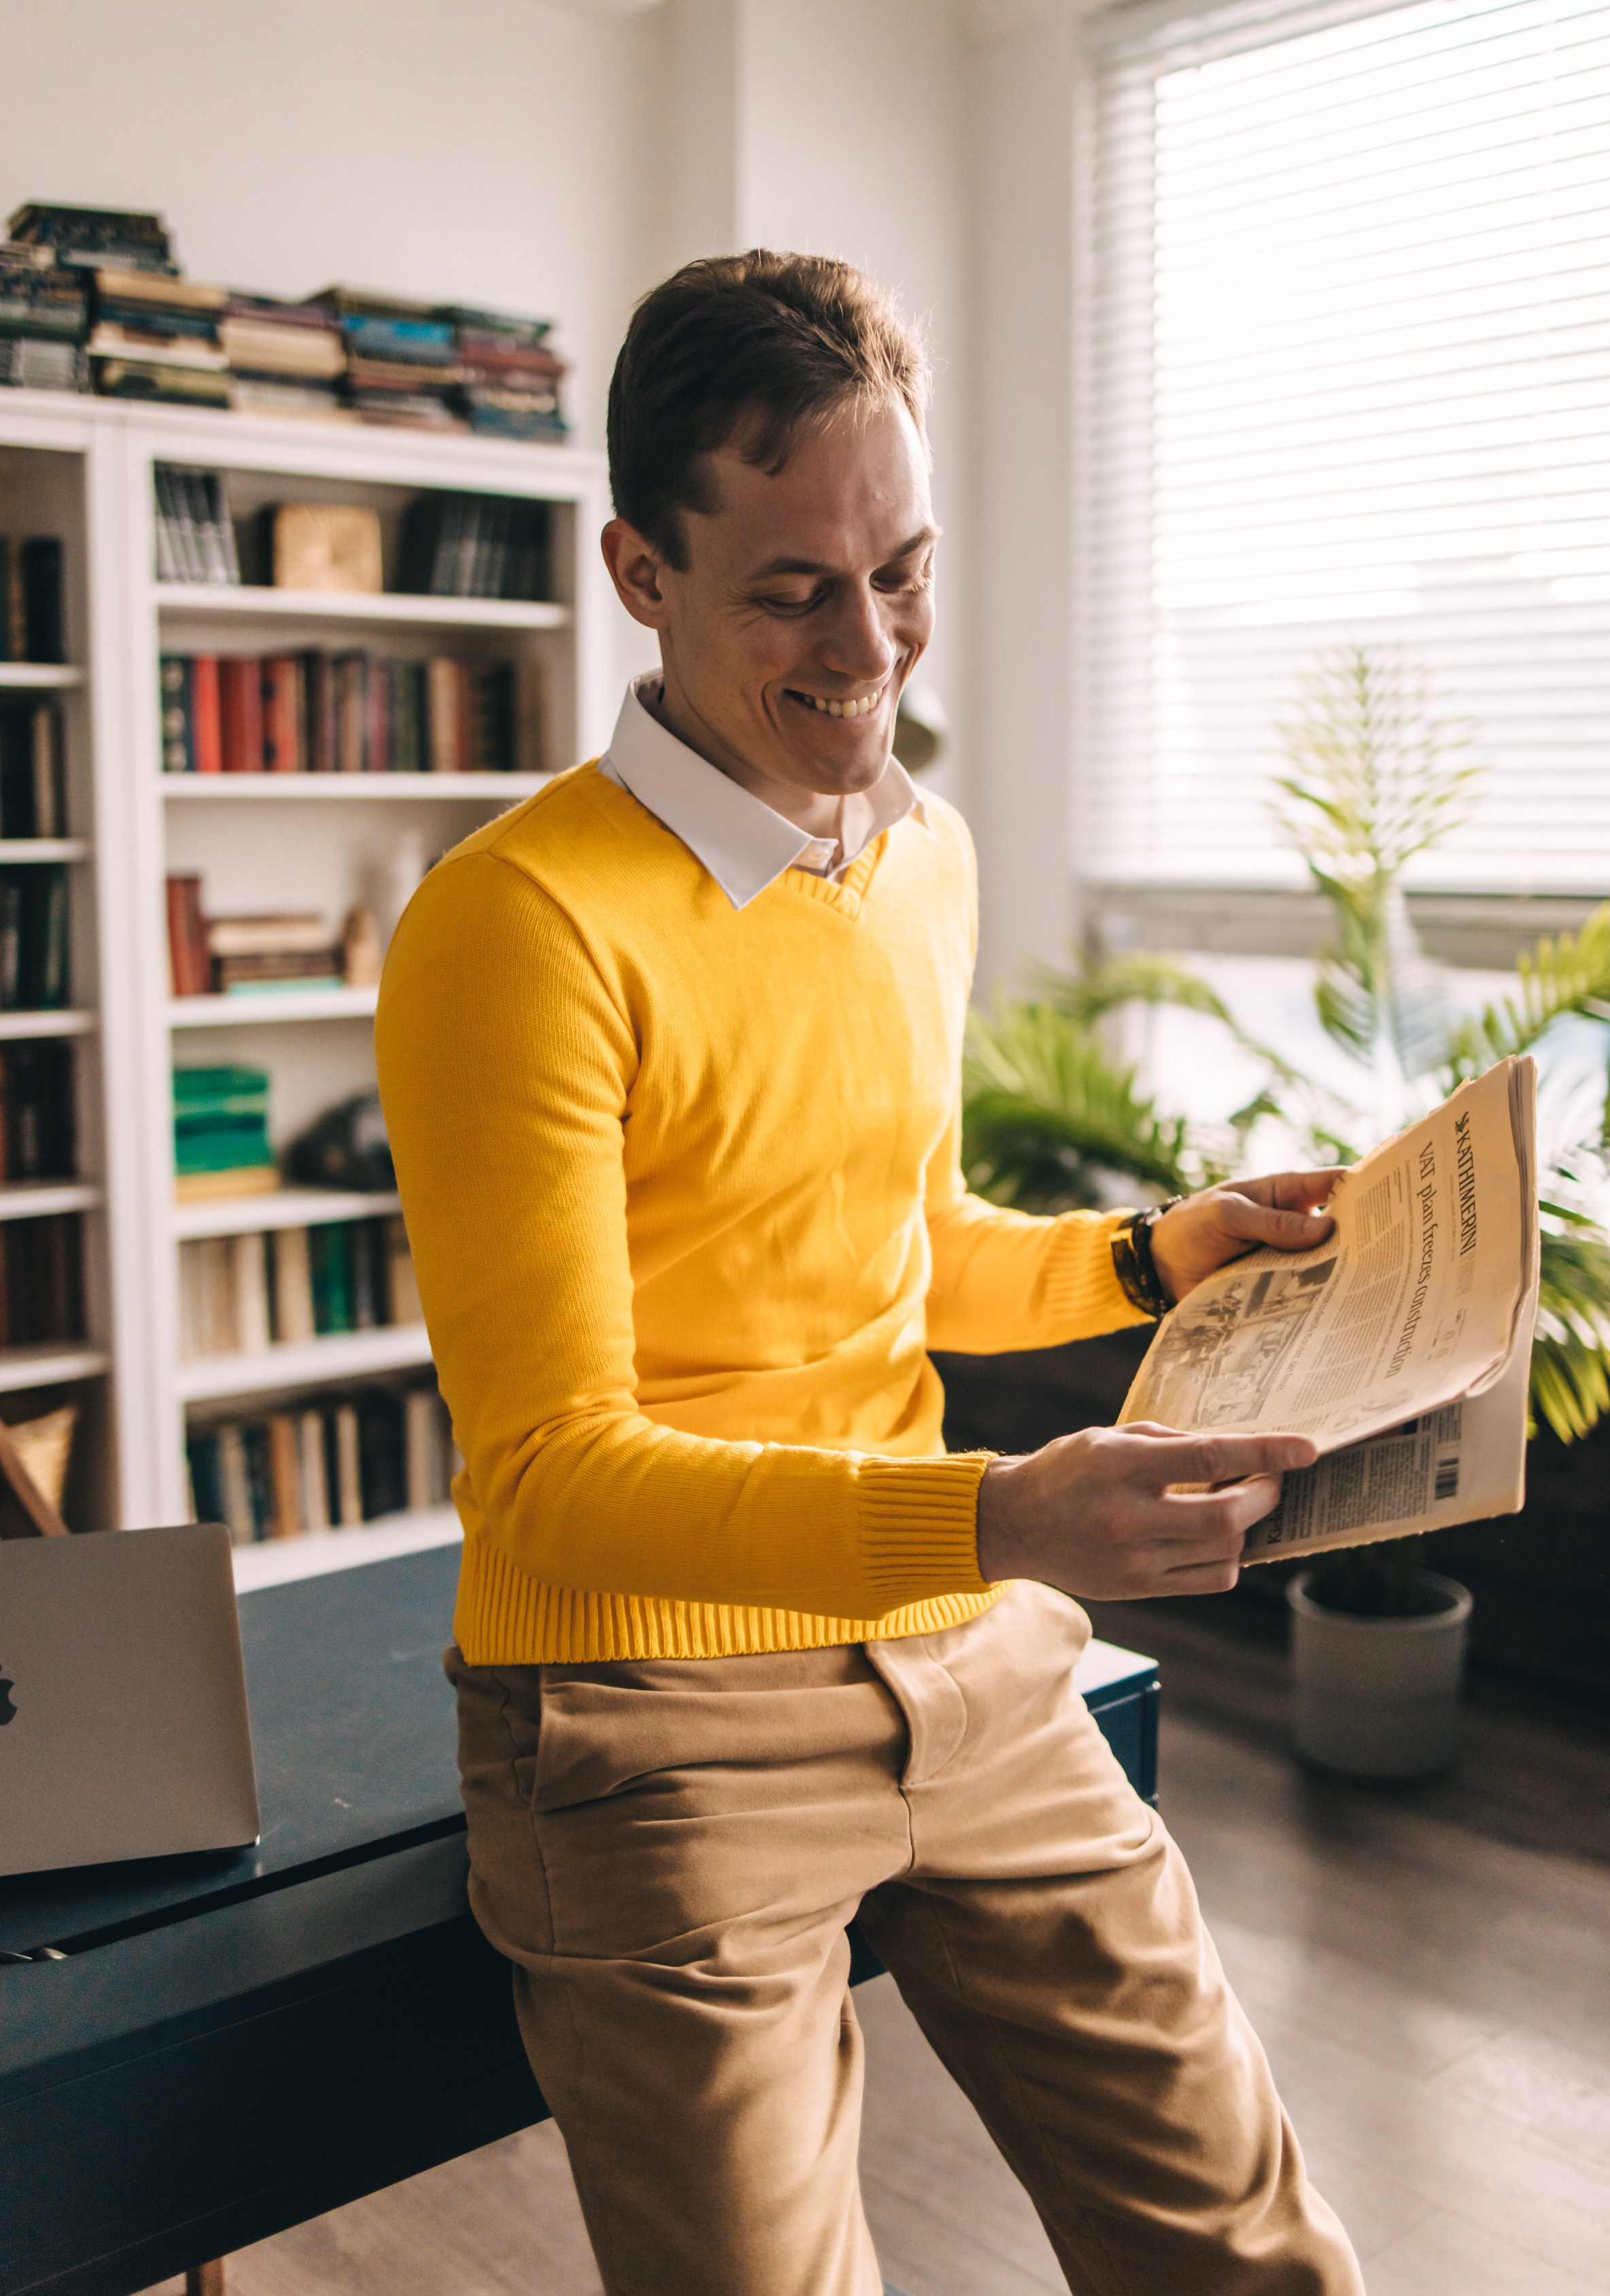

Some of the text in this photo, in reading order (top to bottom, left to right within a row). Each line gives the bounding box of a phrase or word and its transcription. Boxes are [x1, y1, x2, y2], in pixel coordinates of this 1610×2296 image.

[1384, 1141, 1439, 1380] VAT plan freezes construction
[1456, 1128, 1477, 1257] KATHIMERINI
